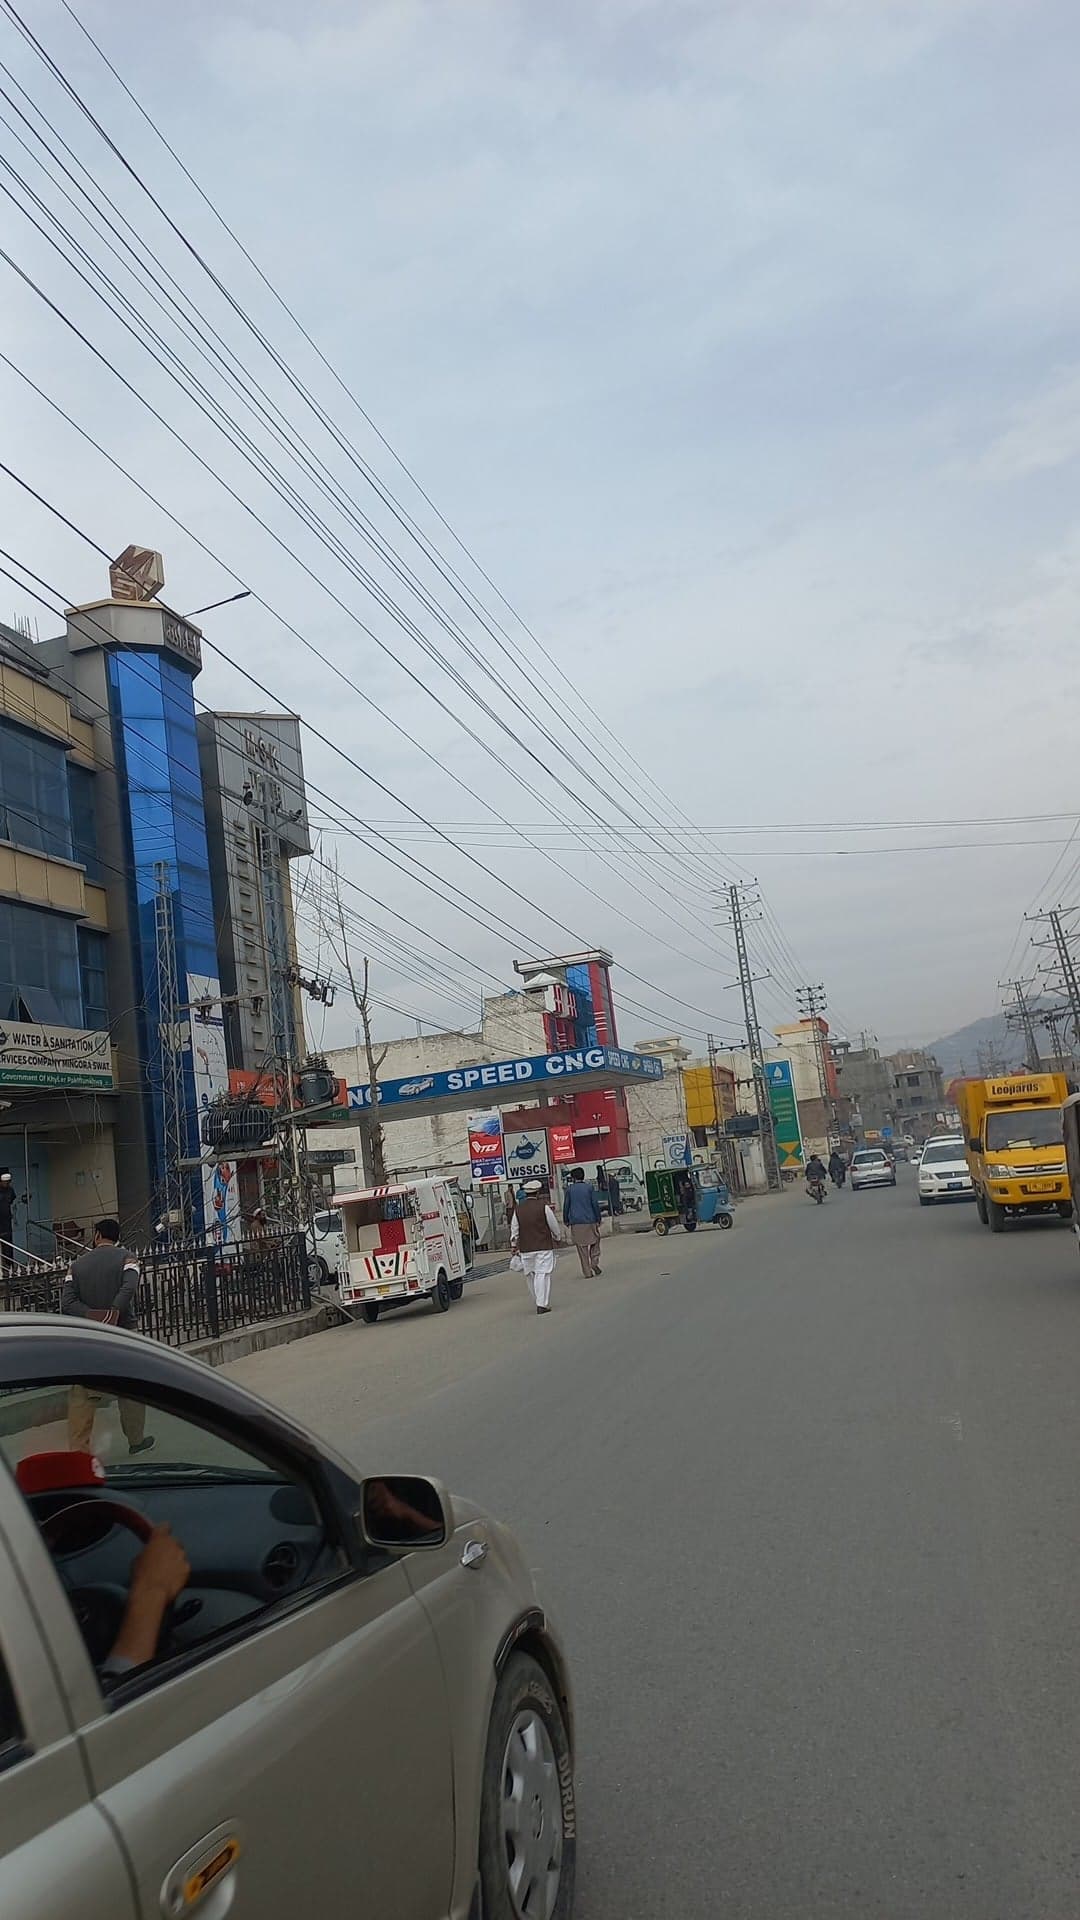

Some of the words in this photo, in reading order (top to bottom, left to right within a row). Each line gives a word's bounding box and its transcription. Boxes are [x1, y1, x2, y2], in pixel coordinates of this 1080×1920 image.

[12, 1032, 41, 1047] WATER
[50, 1036, 93, 1052] SANITATION
[447, 1062, 533, 1090] SPEED
[545, 1050, 604, 1075] CNG
[991, 1082, 1039, 1096] Leopards
[663, 1135, 685, 1143] SPEED
[480, 1143, 499, 1153] TCS
[510, 1164, 547, 1176] WSSCS
